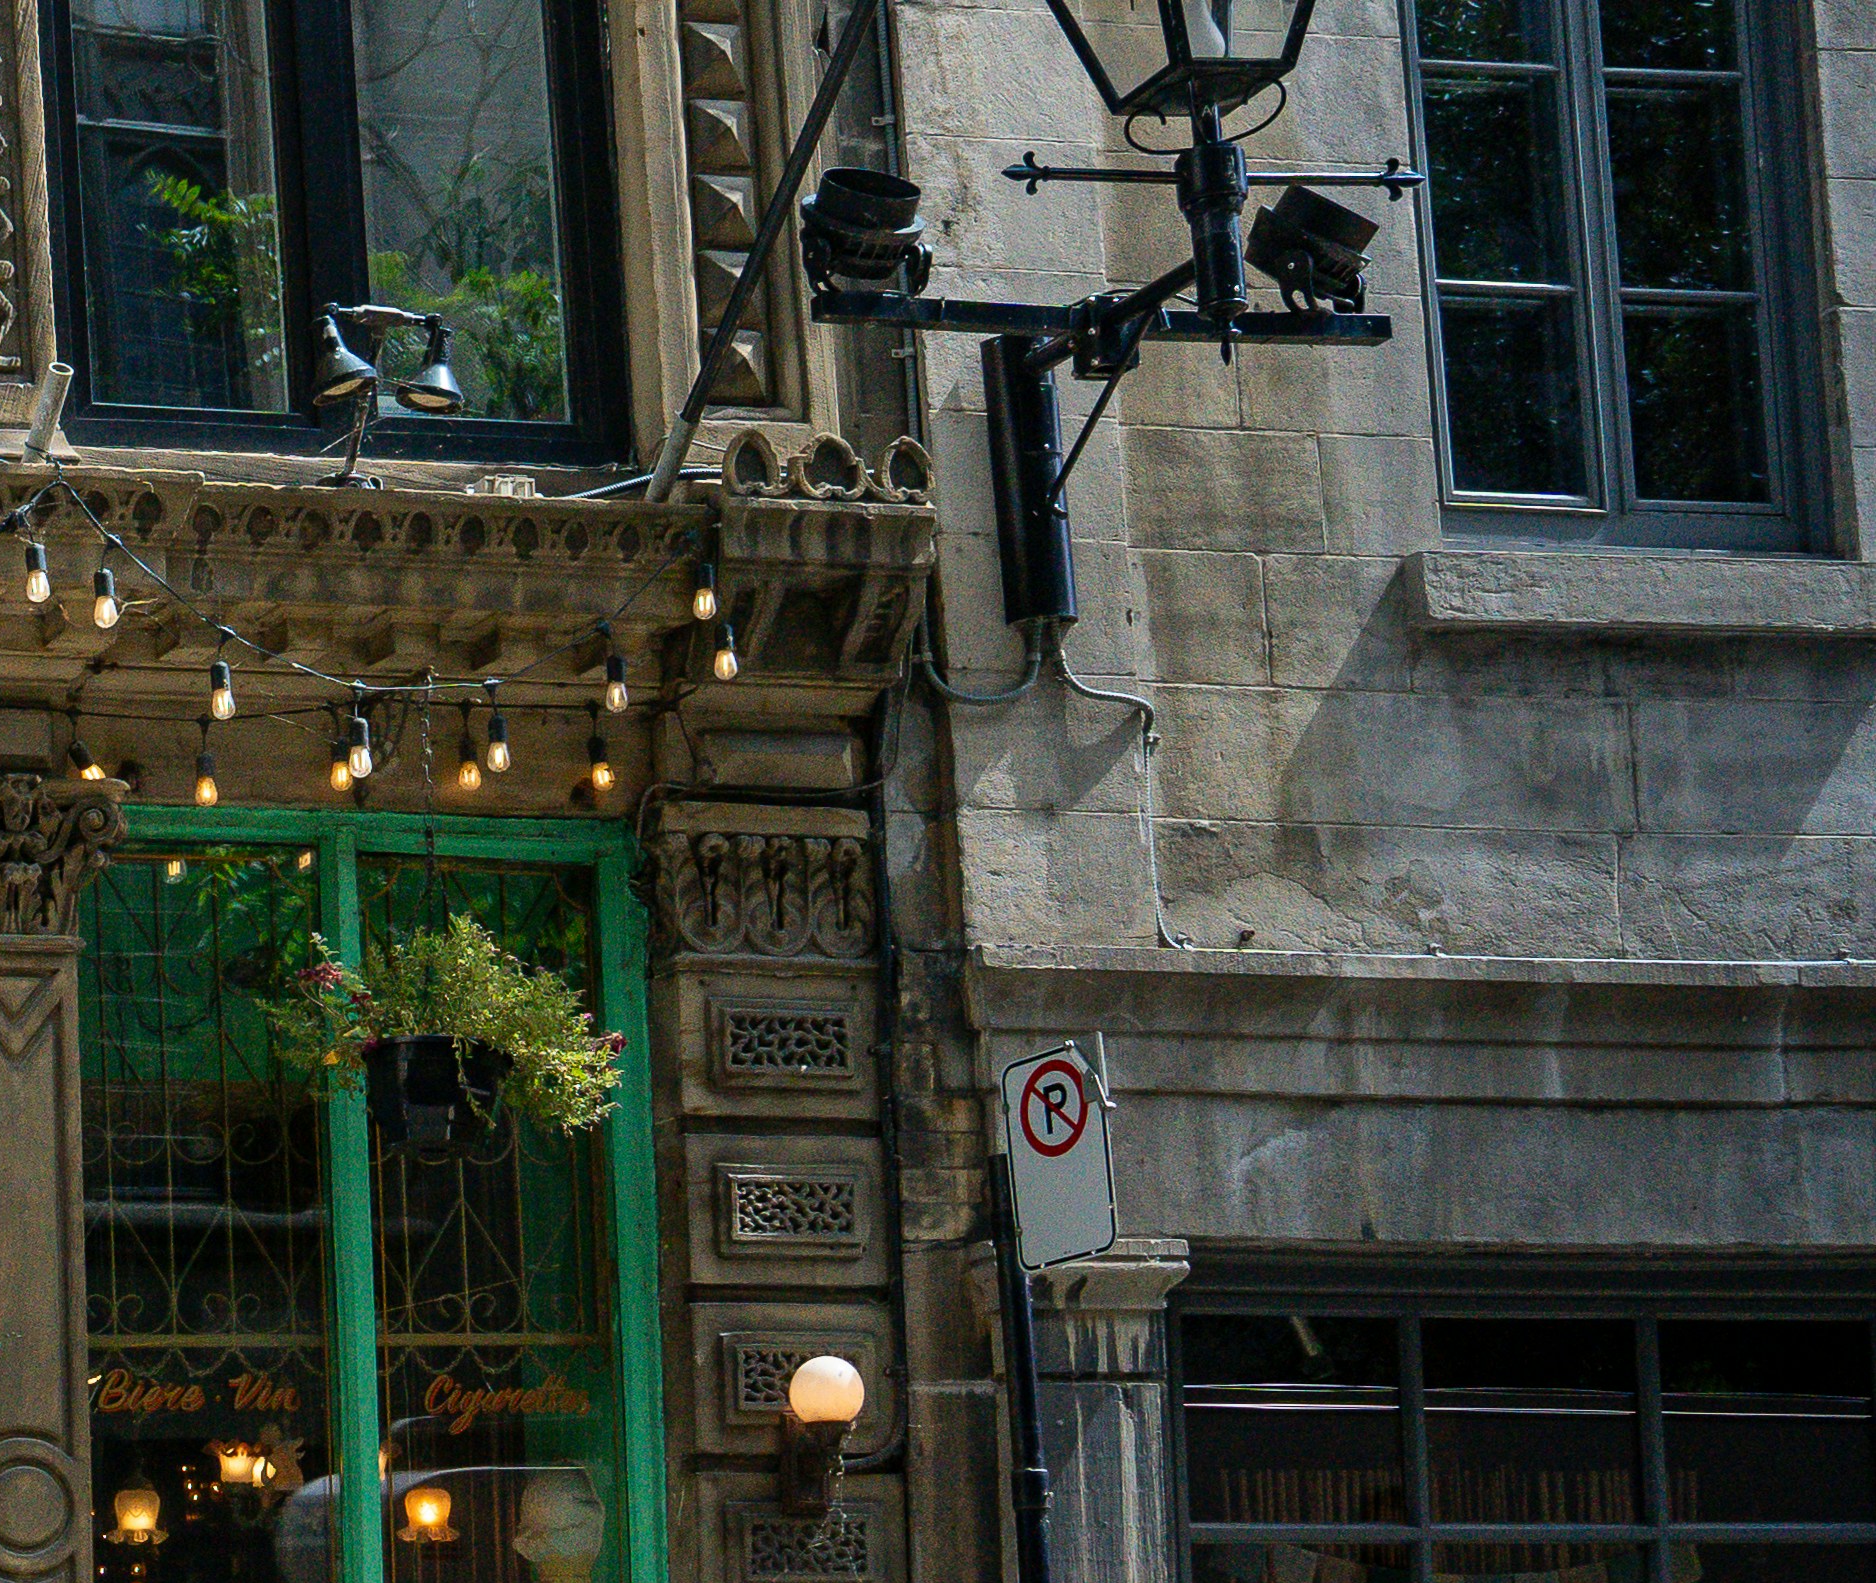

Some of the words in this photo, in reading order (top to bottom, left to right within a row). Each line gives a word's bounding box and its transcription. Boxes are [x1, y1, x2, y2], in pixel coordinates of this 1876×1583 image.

[1043, 1082, 1067, 1135] P
[98, 1368, 206, 1413] Bière
[228, 1372, 301, 1412] Vin
[424, 1373, 591, 1435] Cigarettes
